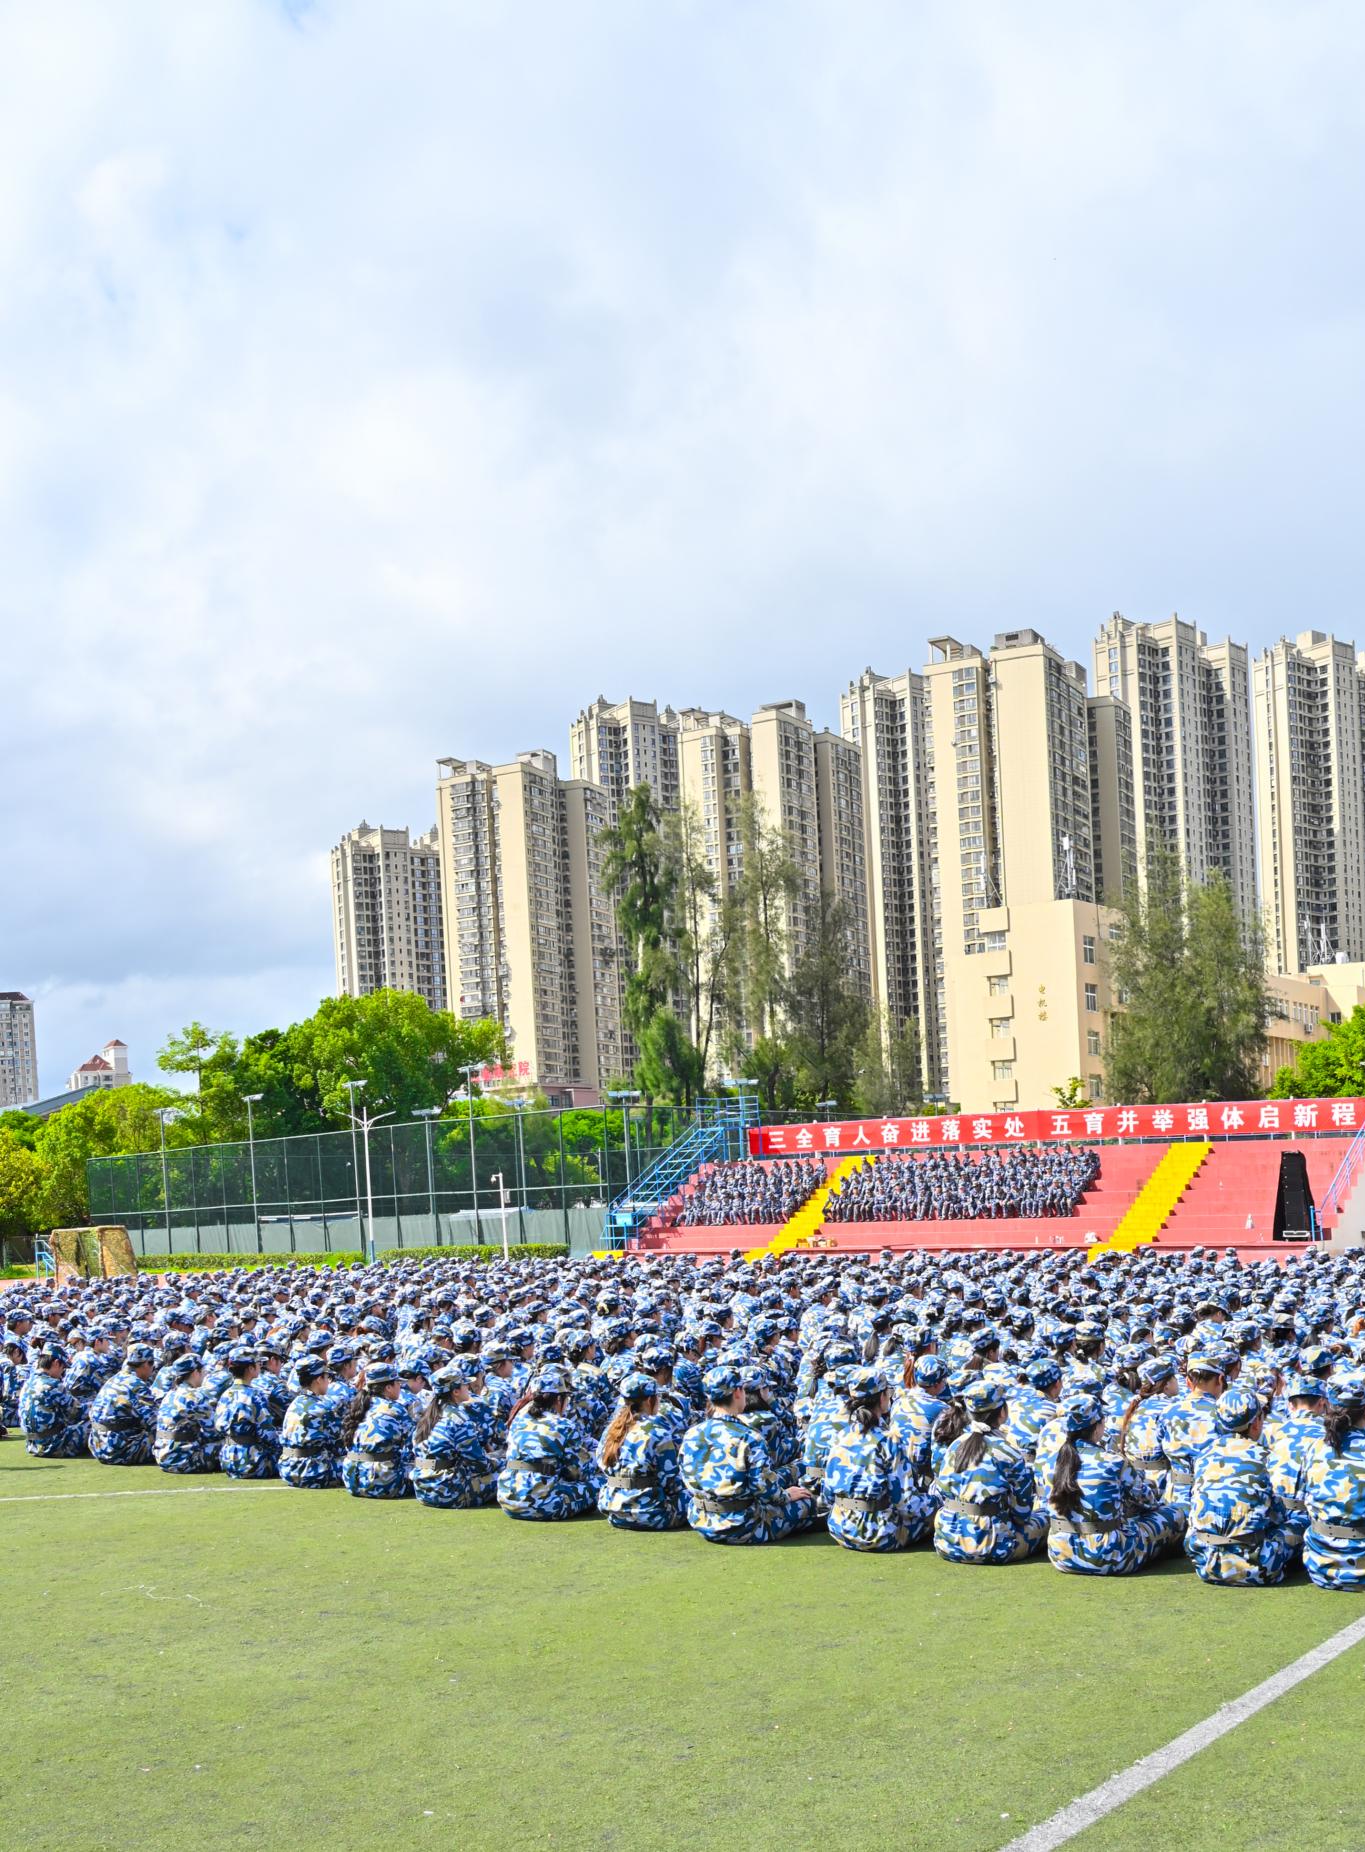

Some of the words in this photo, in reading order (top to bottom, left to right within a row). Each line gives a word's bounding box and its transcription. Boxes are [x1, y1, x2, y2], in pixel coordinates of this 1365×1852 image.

[768, 1116, 1025, 1150] 三全育人奋进落实处
[1050, 1102, 1356, 1135] 五育并举强体启新程
